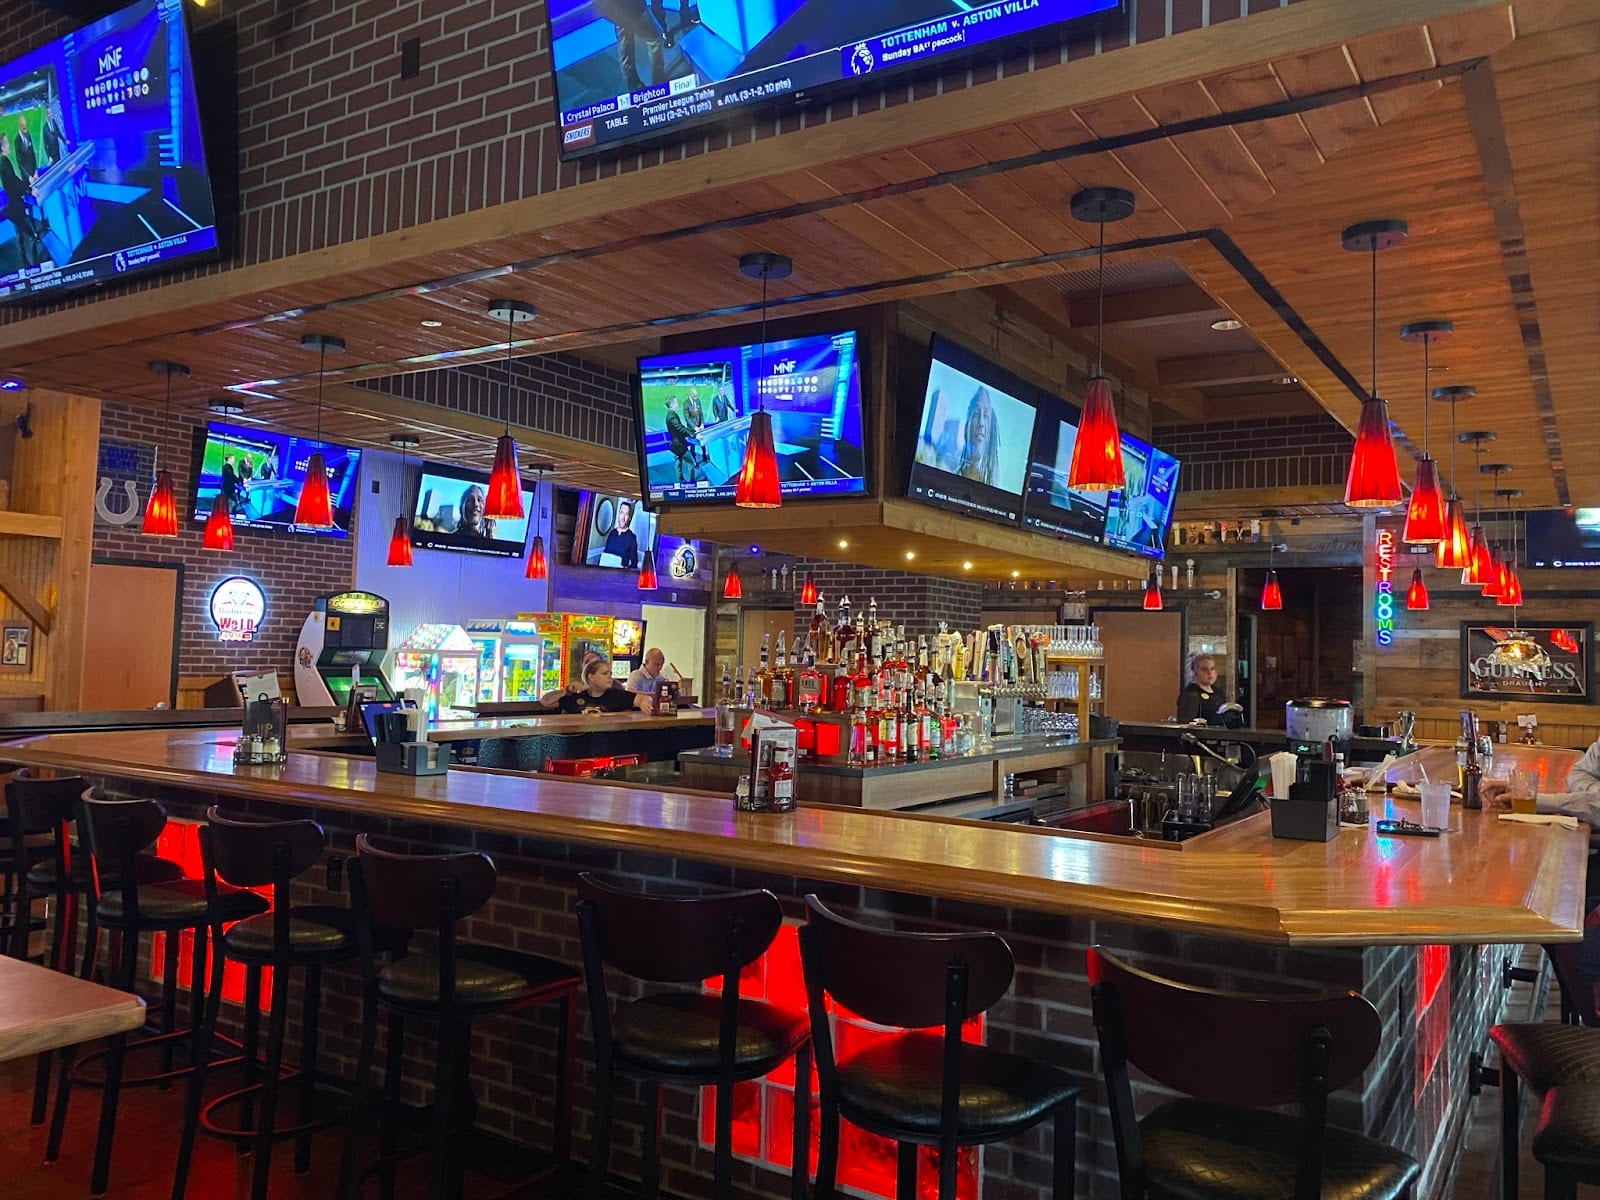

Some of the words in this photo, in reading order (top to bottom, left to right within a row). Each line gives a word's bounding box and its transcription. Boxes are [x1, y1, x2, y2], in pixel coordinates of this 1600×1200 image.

[881, 22, 947, 48] TOTTENHAM
[951, 20, 960, 28] v.
[963, 7, 1002, 27] ASTON
[1004, 0, 1039, 15] VILLA
[98, 46, 122, 74] MNF
[882, 47, 912, 62] Sunday
[931, 32, 963, 51] peacock
[566, 109, 592, 122] Crystal
[592, 102, 615, 116] Palace
[632, 87, 667, 104] Brighton
[674, 79, 692, 91] Final
[642, 102, 668, 116] Premier
[669, 95, 695, 109] League
[694, 88, 715, 100] Table
[725, 93, 739, 105] AVL
[774, 78, 792, 93] pts)
[605, 116, 629, 129] TABLE
[649, 112, 666, 125] WHU
[696, 100, 713, 113] pts)
[565, 127, 592, 142] SNICKERS
[773, 360, 796, 375] MNF
[1378, 532, 1393, 645] RESTROOMS
